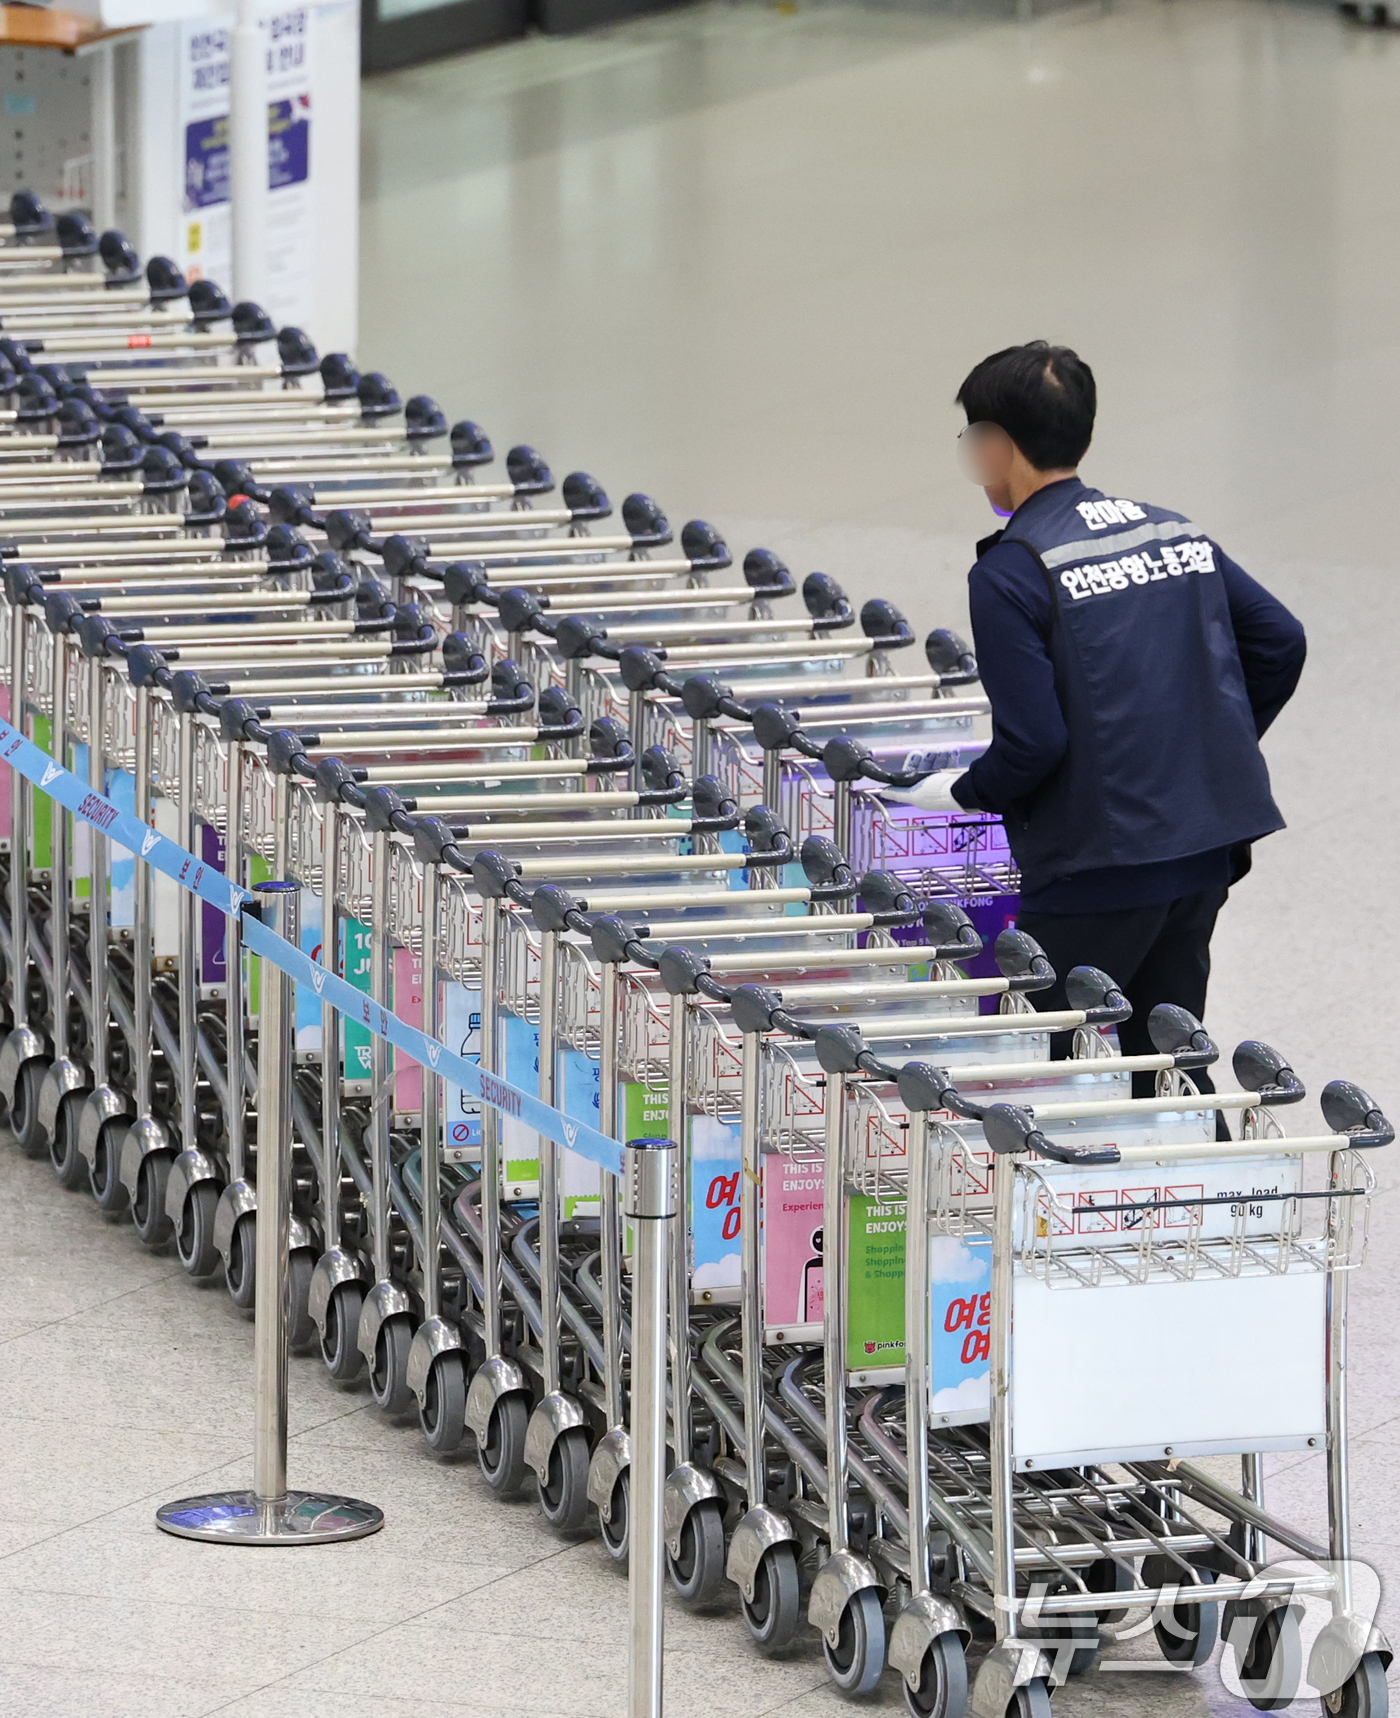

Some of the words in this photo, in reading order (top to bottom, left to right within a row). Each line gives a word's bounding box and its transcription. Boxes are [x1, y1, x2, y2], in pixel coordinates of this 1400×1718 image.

[1075, 499, 1147, 531] 한마음
[1060, 541, 1216, 600] 인천공항노동조합
[78, 793, 119, 829] SECURITY
[479, 1074, 521, 1117] SECURITY
[643, 1093, 669, 1105] THIS
[783, 1164, 808, 1174] THIS
[812, 1163, 822, 1173] IS
[706, 1172, 741, 1209] 여
[866, 1206, 892, 1217] THIS
[895, 1205, 906, 1216] IS
[1230, 1204, 1245, 1217] 90
[1249, 1203, 1263, 1218] kg
[877, 1341, 906, 1350] pinkfo
